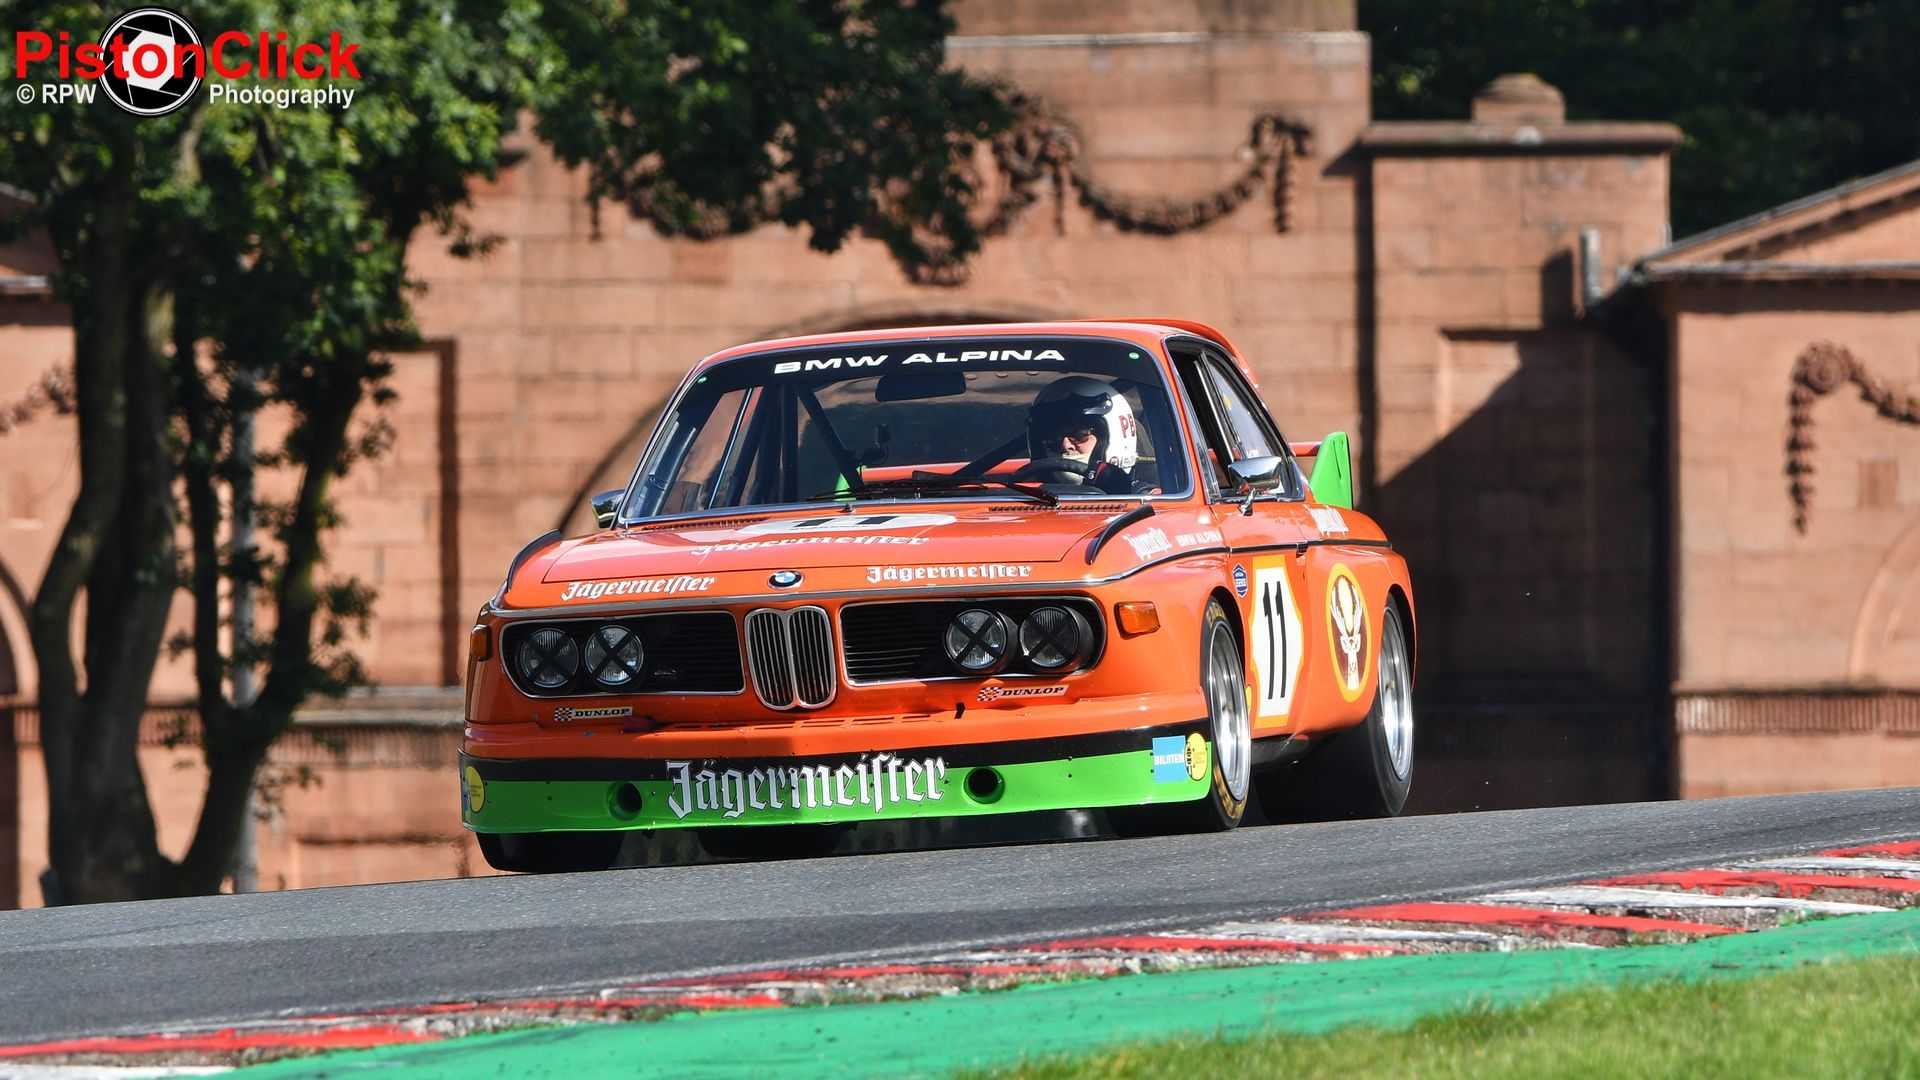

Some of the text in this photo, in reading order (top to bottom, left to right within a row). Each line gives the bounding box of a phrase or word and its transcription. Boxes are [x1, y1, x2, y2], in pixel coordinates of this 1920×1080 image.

[773, 349, 1066, 374] BMW ALPINA
[1262, 580, 1288, 700] 11
[1001, 686, 1064, 697] DUNLOP
[574, 708, 630, 717] DUNLOP
